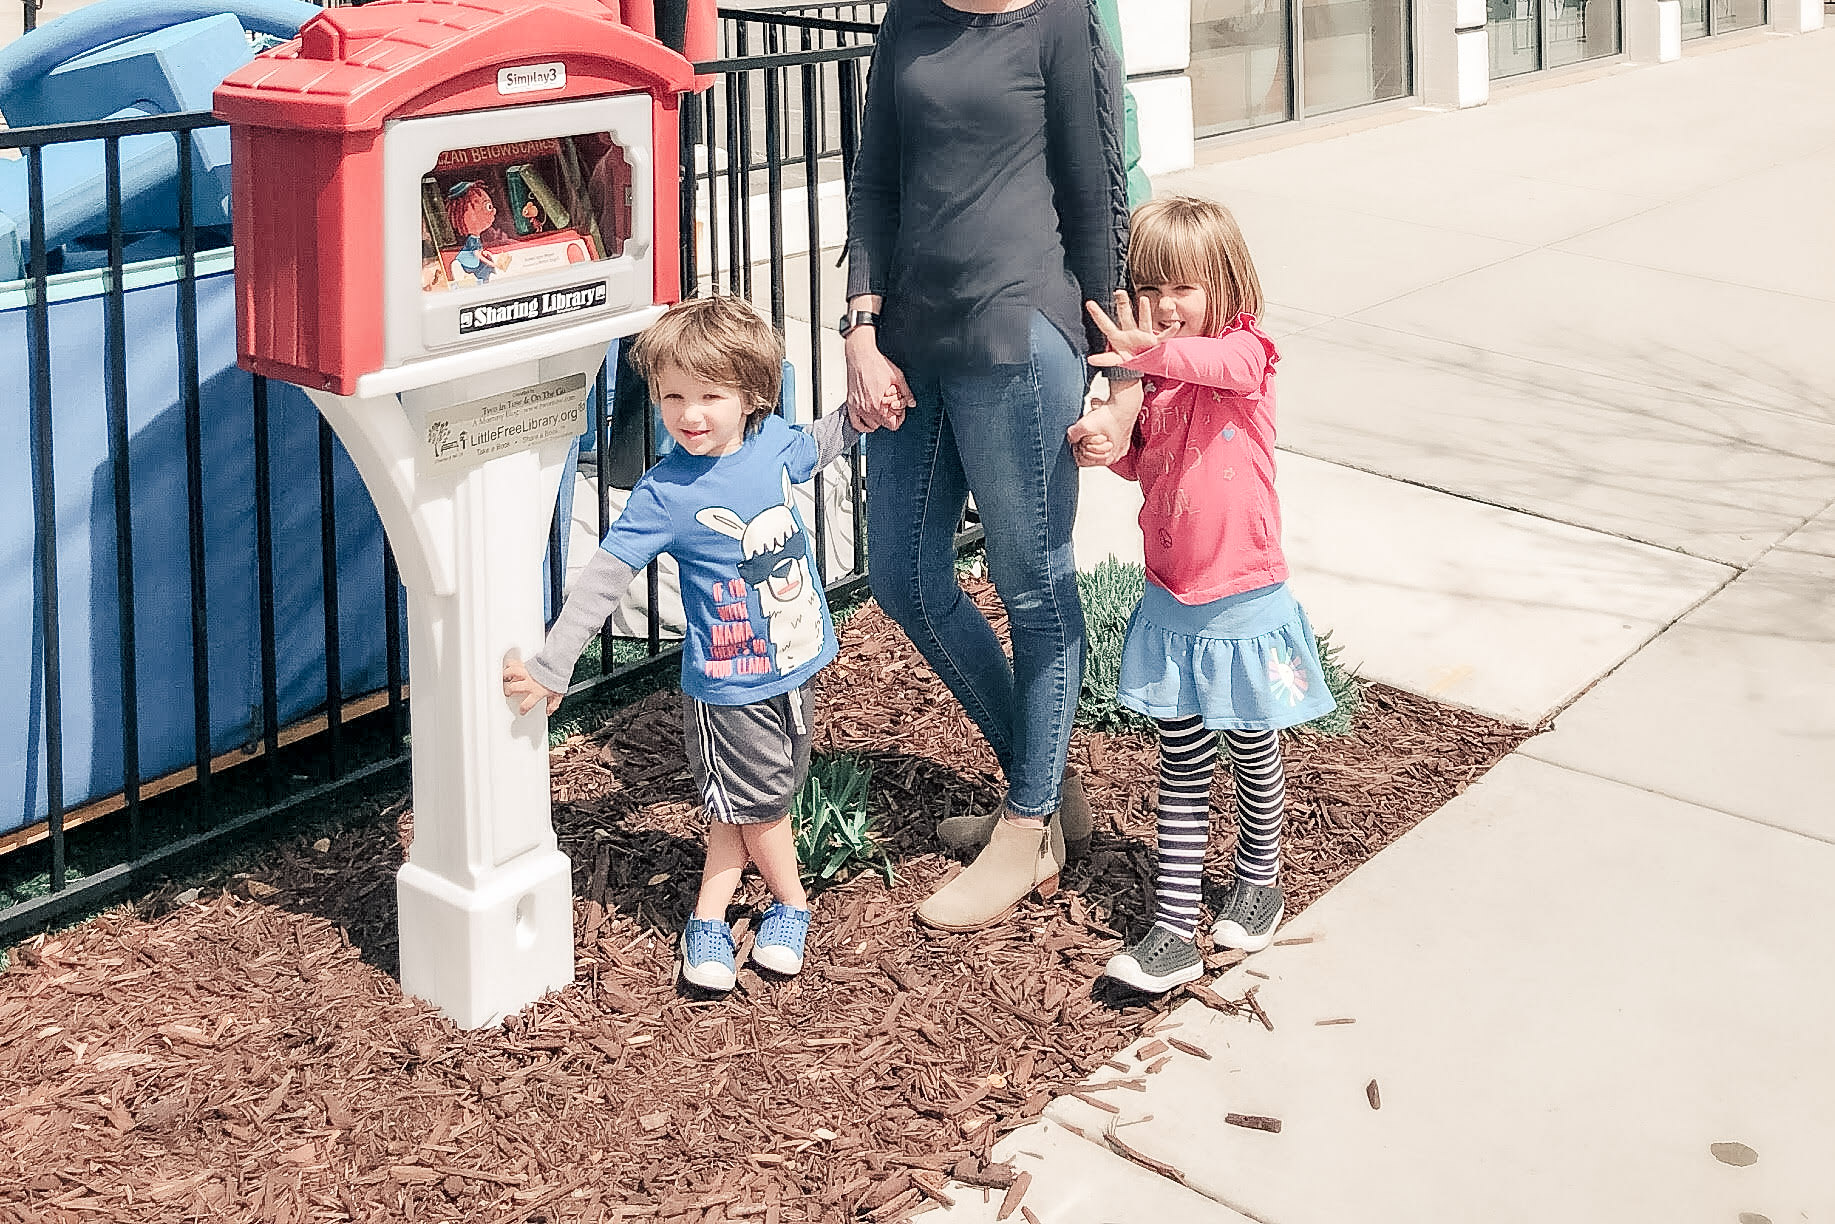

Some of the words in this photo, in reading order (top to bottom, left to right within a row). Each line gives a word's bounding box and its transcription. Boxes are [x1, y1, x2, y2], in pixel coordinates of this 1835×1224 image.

[506, 68, 557, 86] Simplay3
[474, 296, 540, 327] Sharing
[542, 287, 596, 314] Library
[711, 621, 755, 646] MAMA
[737, 656, 773, 675] LLAMA
